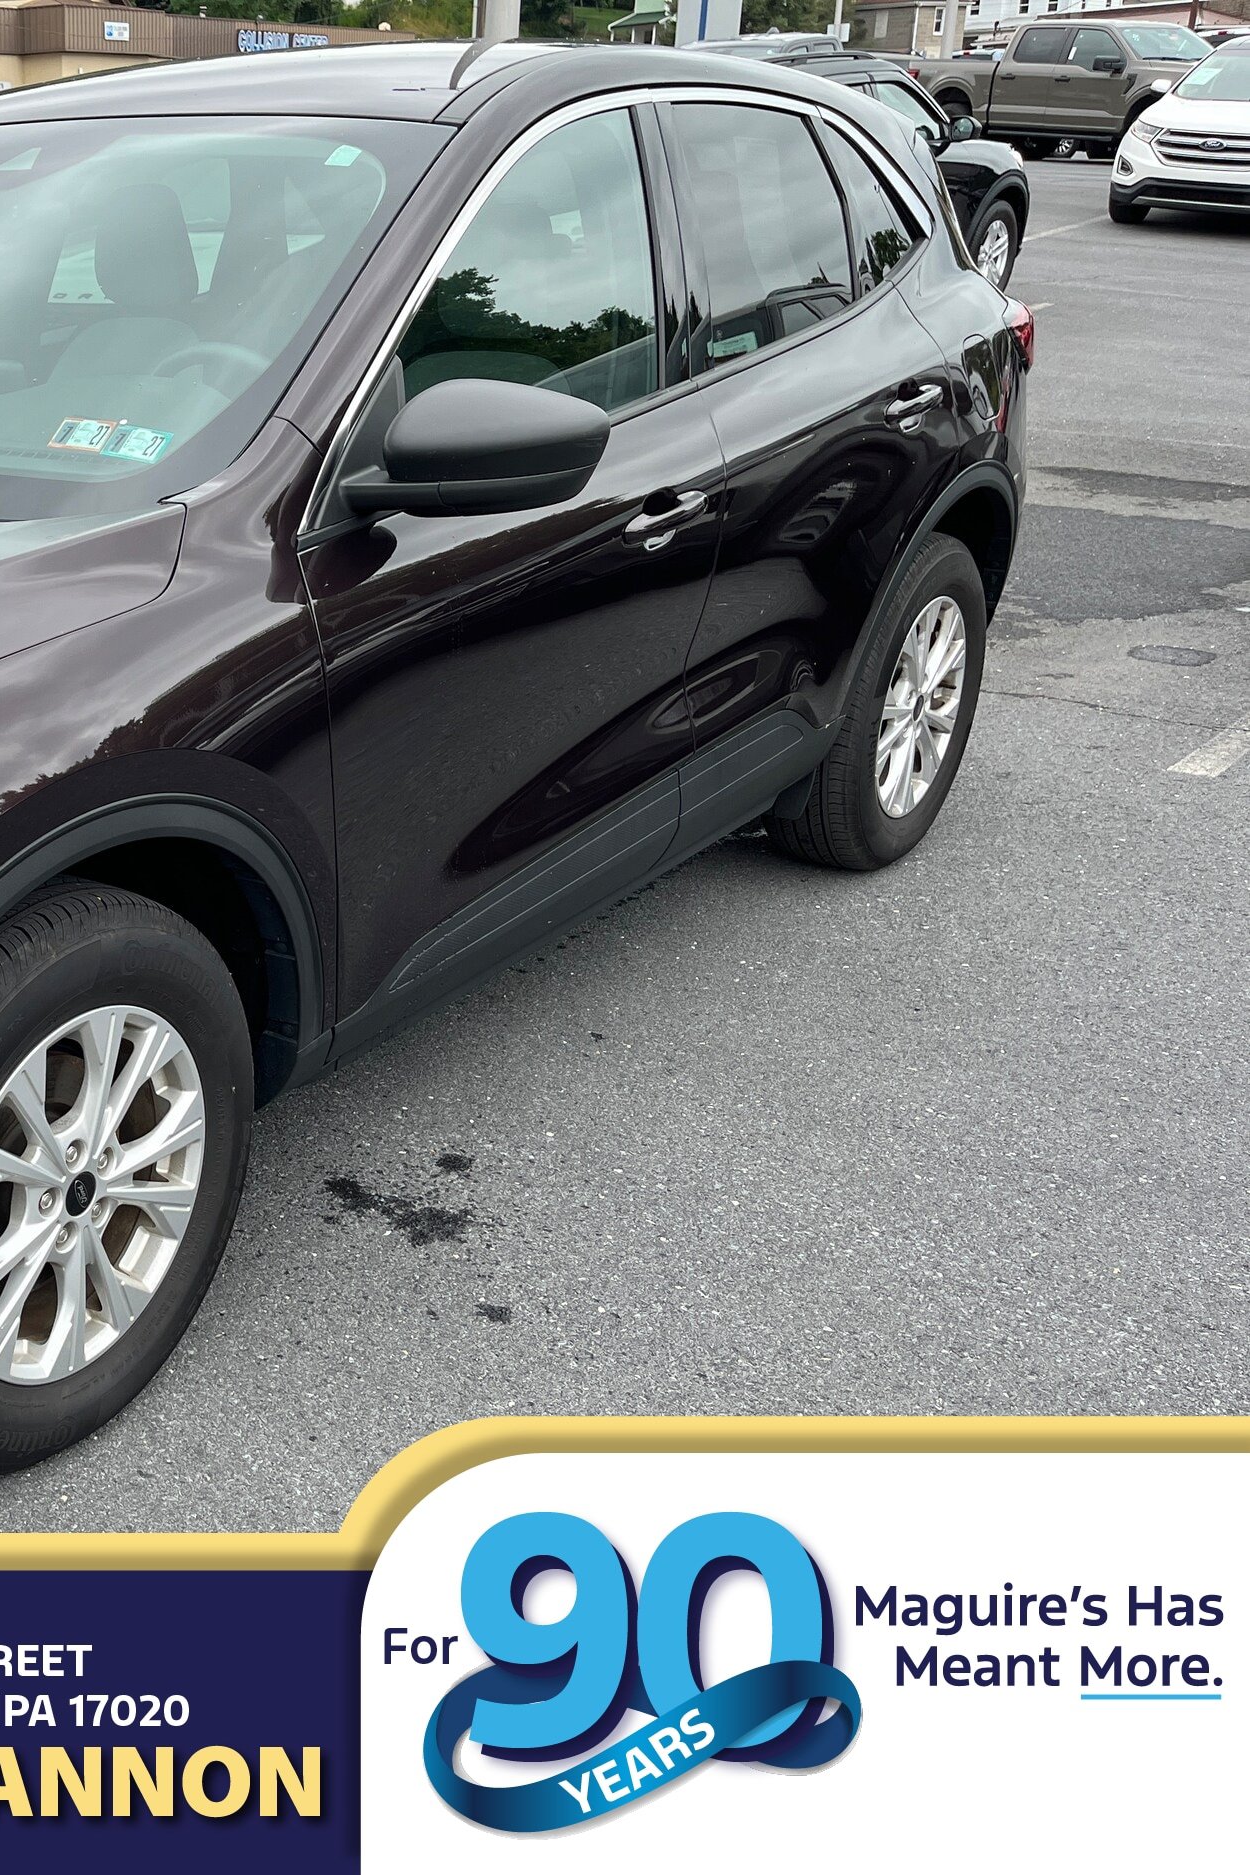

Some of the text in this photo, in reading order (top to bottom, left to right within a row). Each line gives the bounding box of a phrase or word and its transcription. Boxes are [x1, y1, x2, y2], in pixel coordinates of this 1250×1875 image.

[238, 29, 290, 53] COLLISION
[89, 425, 110, 446] 27
[142, 435, 165, 457] 27
